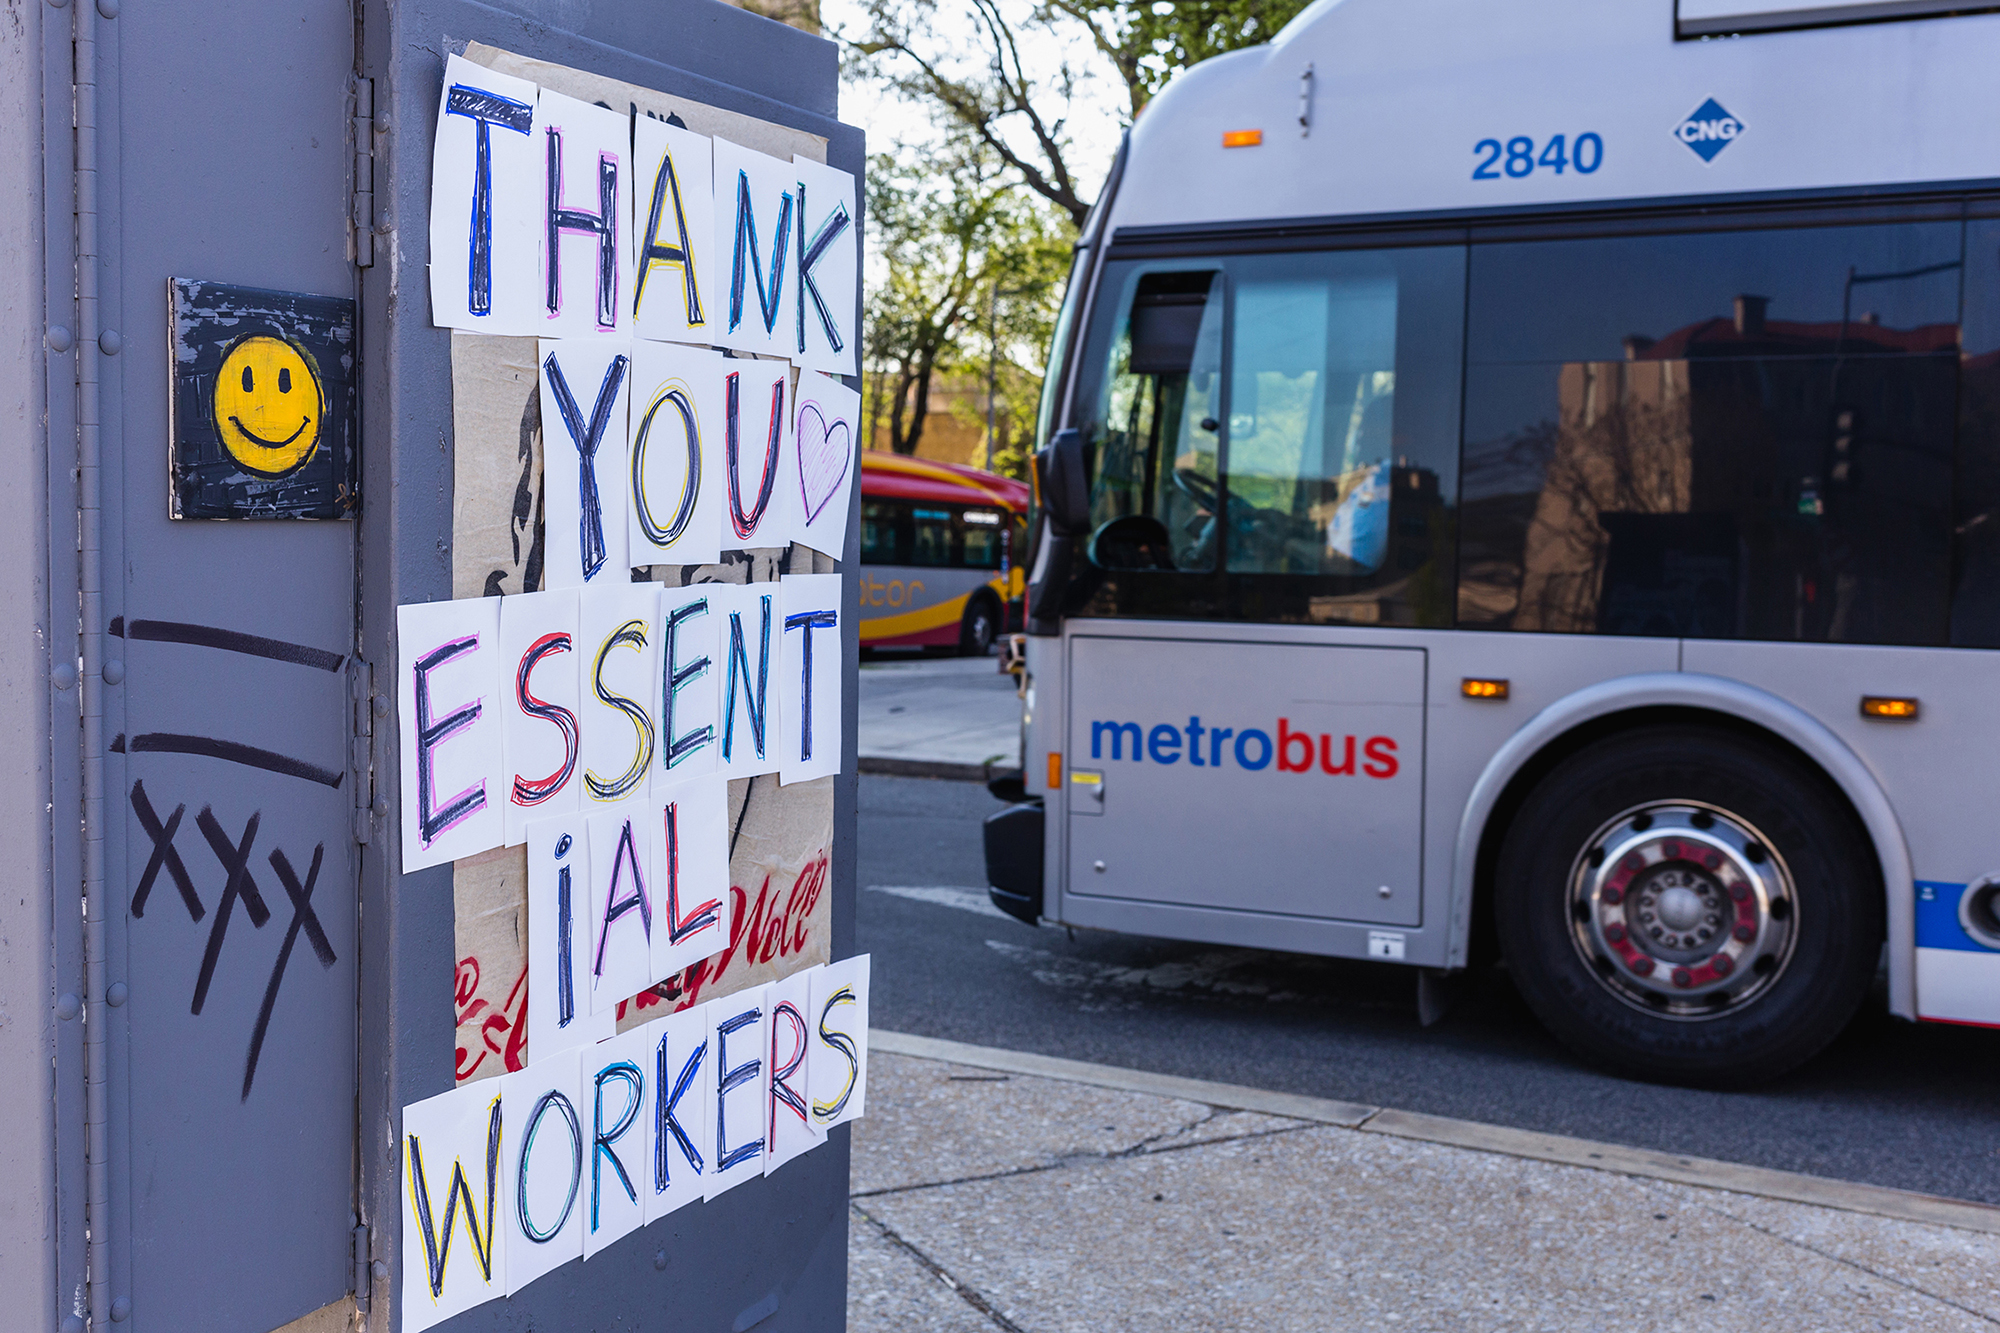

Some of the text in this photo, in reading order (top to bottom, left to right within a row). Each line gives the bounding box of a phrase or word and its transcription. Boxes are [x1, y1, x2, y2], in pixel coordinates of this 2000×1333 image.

[446, 82, 851, 355] THANK
[1471, 131, 1604, 180] 2840
[1680, 117, 1737, 143] CNG
[543, 350, 785, 583] YOU
[413, 594, 838, 850] ESSENT
[1091, 716, 1400, 779] metrobus
[403, 983, 860, 1305] WORKERS
